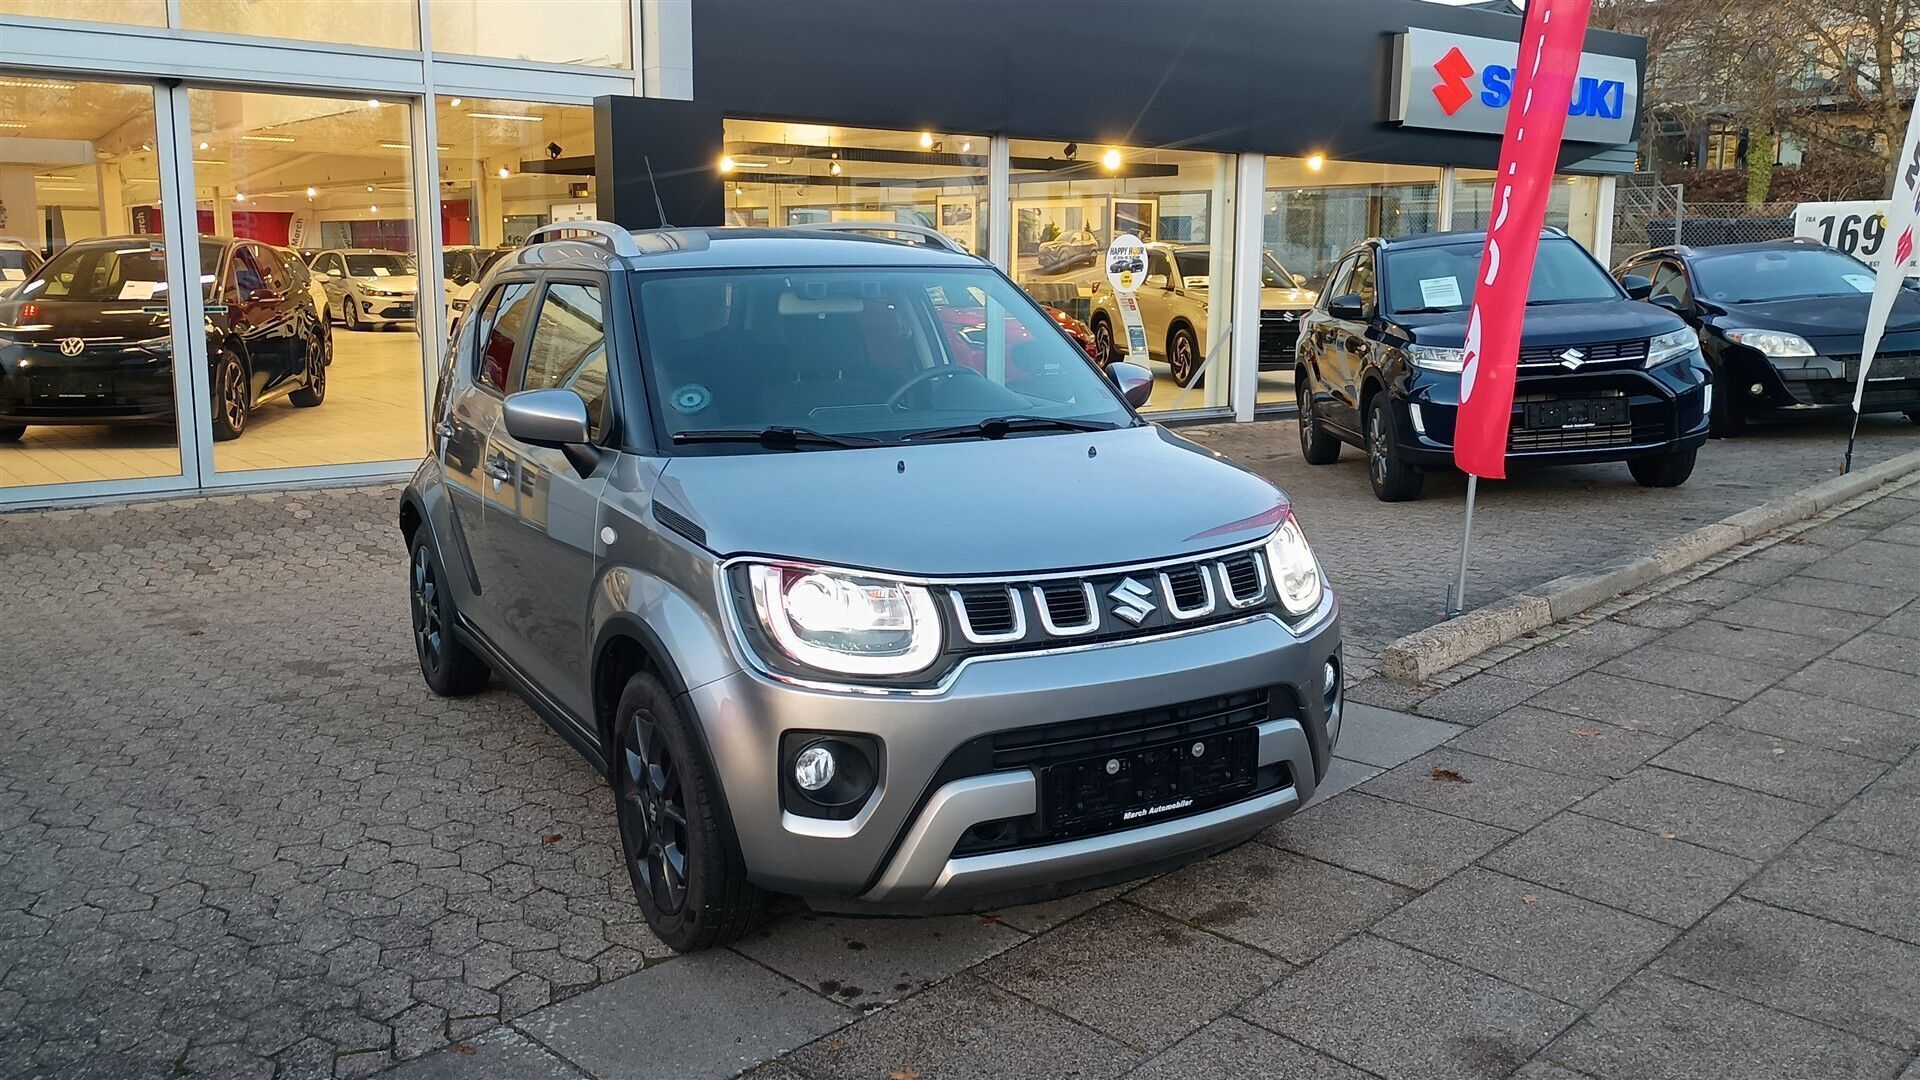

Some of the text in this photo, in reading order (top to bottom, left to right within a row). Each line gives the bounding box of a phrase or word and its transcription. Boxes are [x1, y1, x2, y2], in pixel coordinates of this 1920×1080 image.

[1481, 65, 1624, 119] SUKI
[1110, 247, 1128, 255] HAPPY
[1148, 800, 1193, 814] Automobiler
